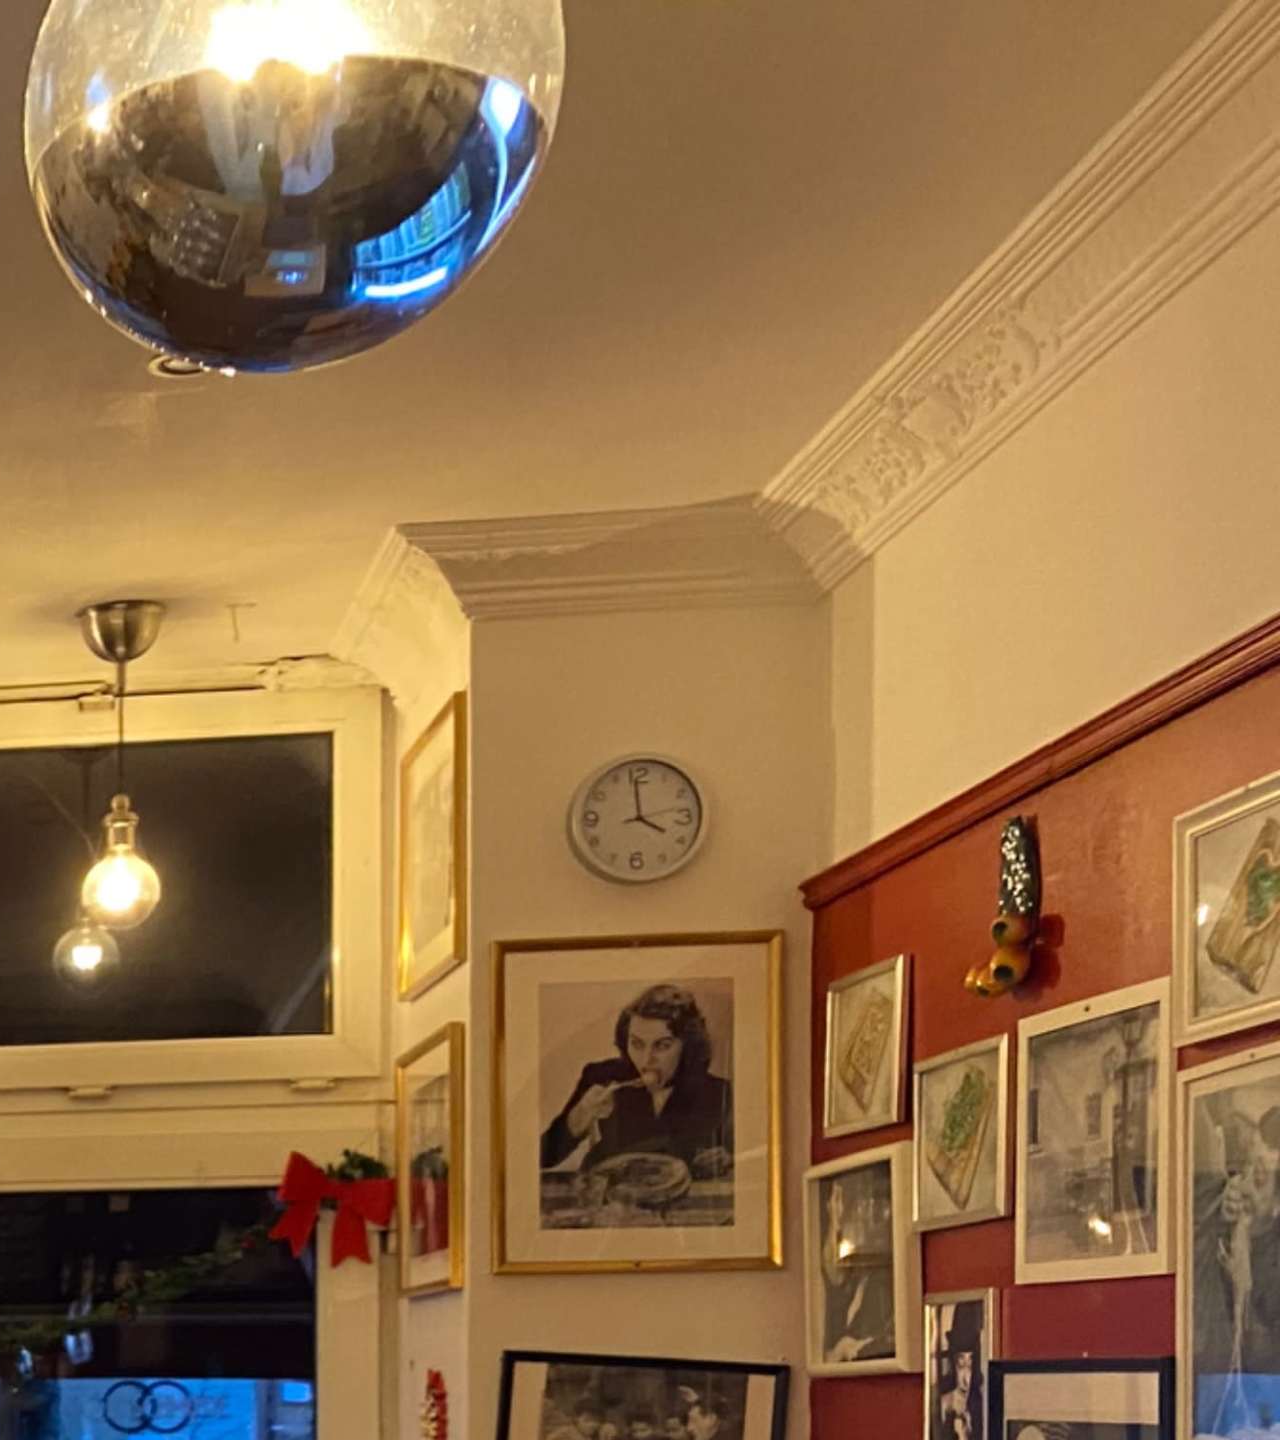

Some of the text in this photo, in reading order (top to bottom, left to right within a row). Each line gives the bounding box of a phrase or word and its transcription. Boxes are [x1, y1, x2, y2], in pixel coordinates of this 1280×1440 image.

[628, 767, 649, 785] 12
[583, 810, 599, 828] 9
[674, 808, 692, 826] 3
[629, 850, 644, 871] 6
